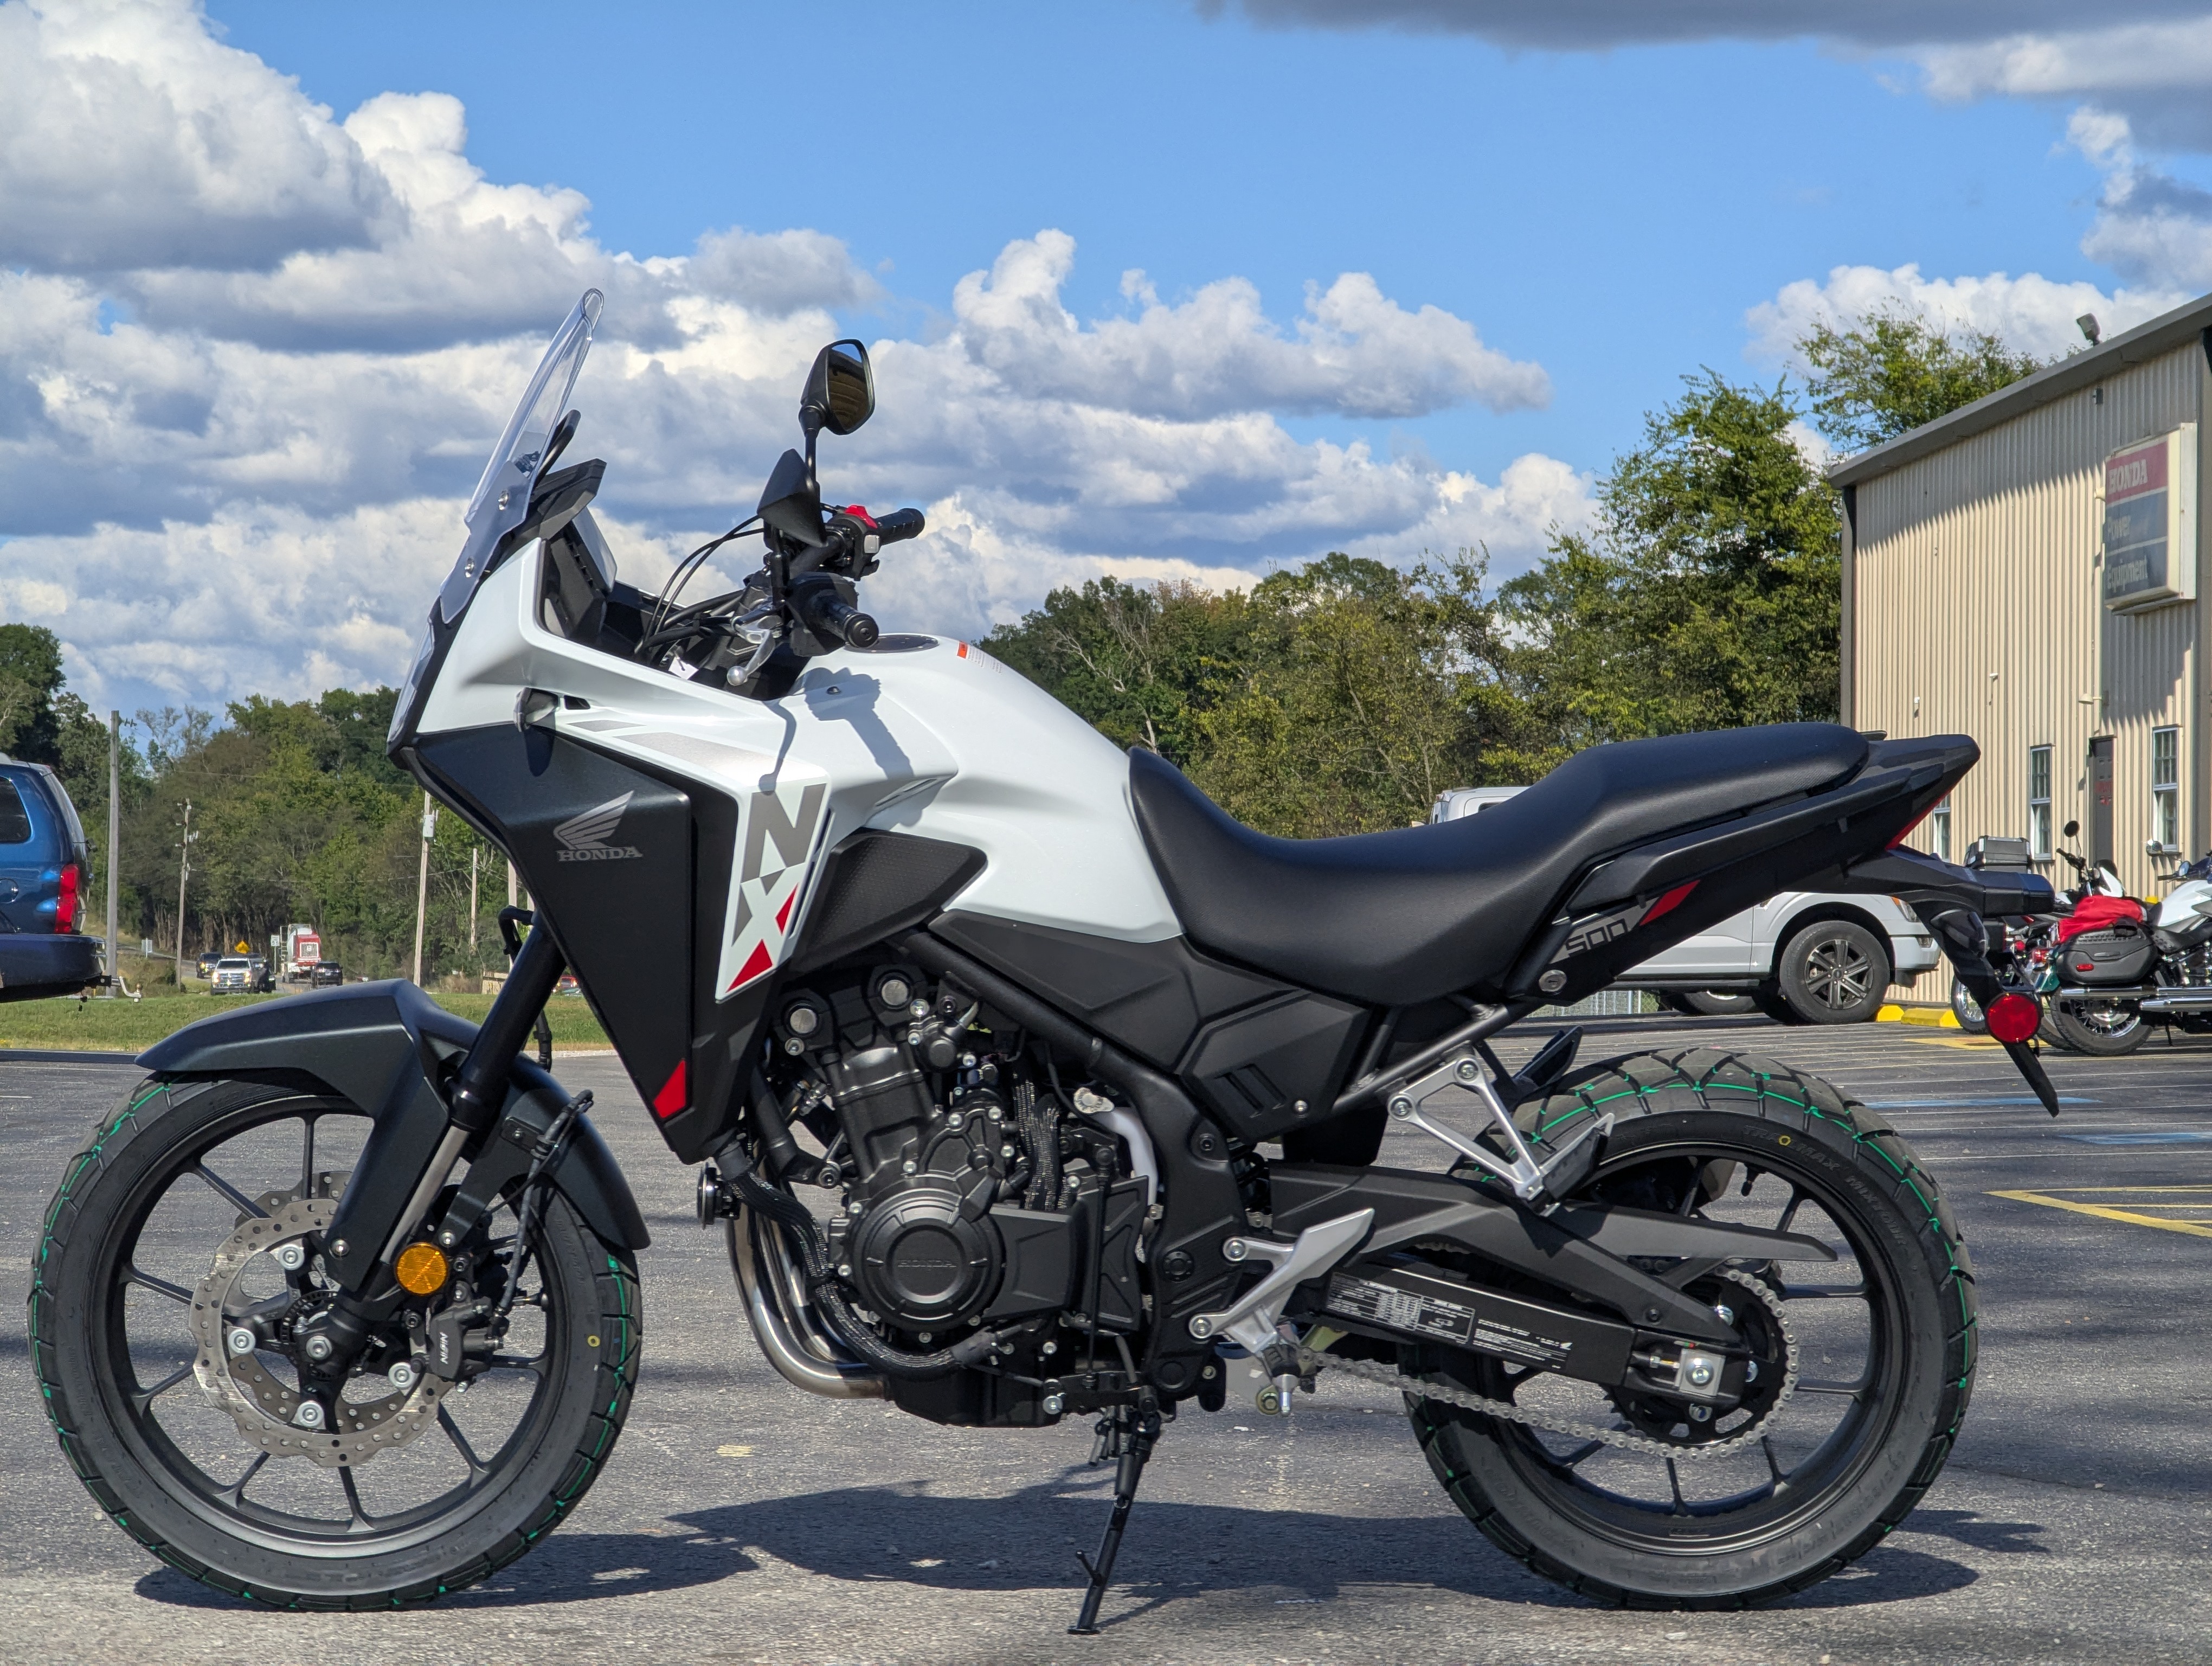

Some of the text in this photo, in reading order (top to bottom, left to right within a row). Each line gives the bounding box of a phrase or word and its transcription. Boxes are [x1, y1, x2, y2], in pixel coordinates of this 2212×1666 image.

[2108, 459, 2147, 494] HONDA
[2107, 515, 2130, 538] Power
[2107, 556, 2148, 592] Equipment
[556, 846, 643, 862] HONDA
[1565, 918, 1629, 957] 500
[896, 1259, 957, 1268] HONDA
